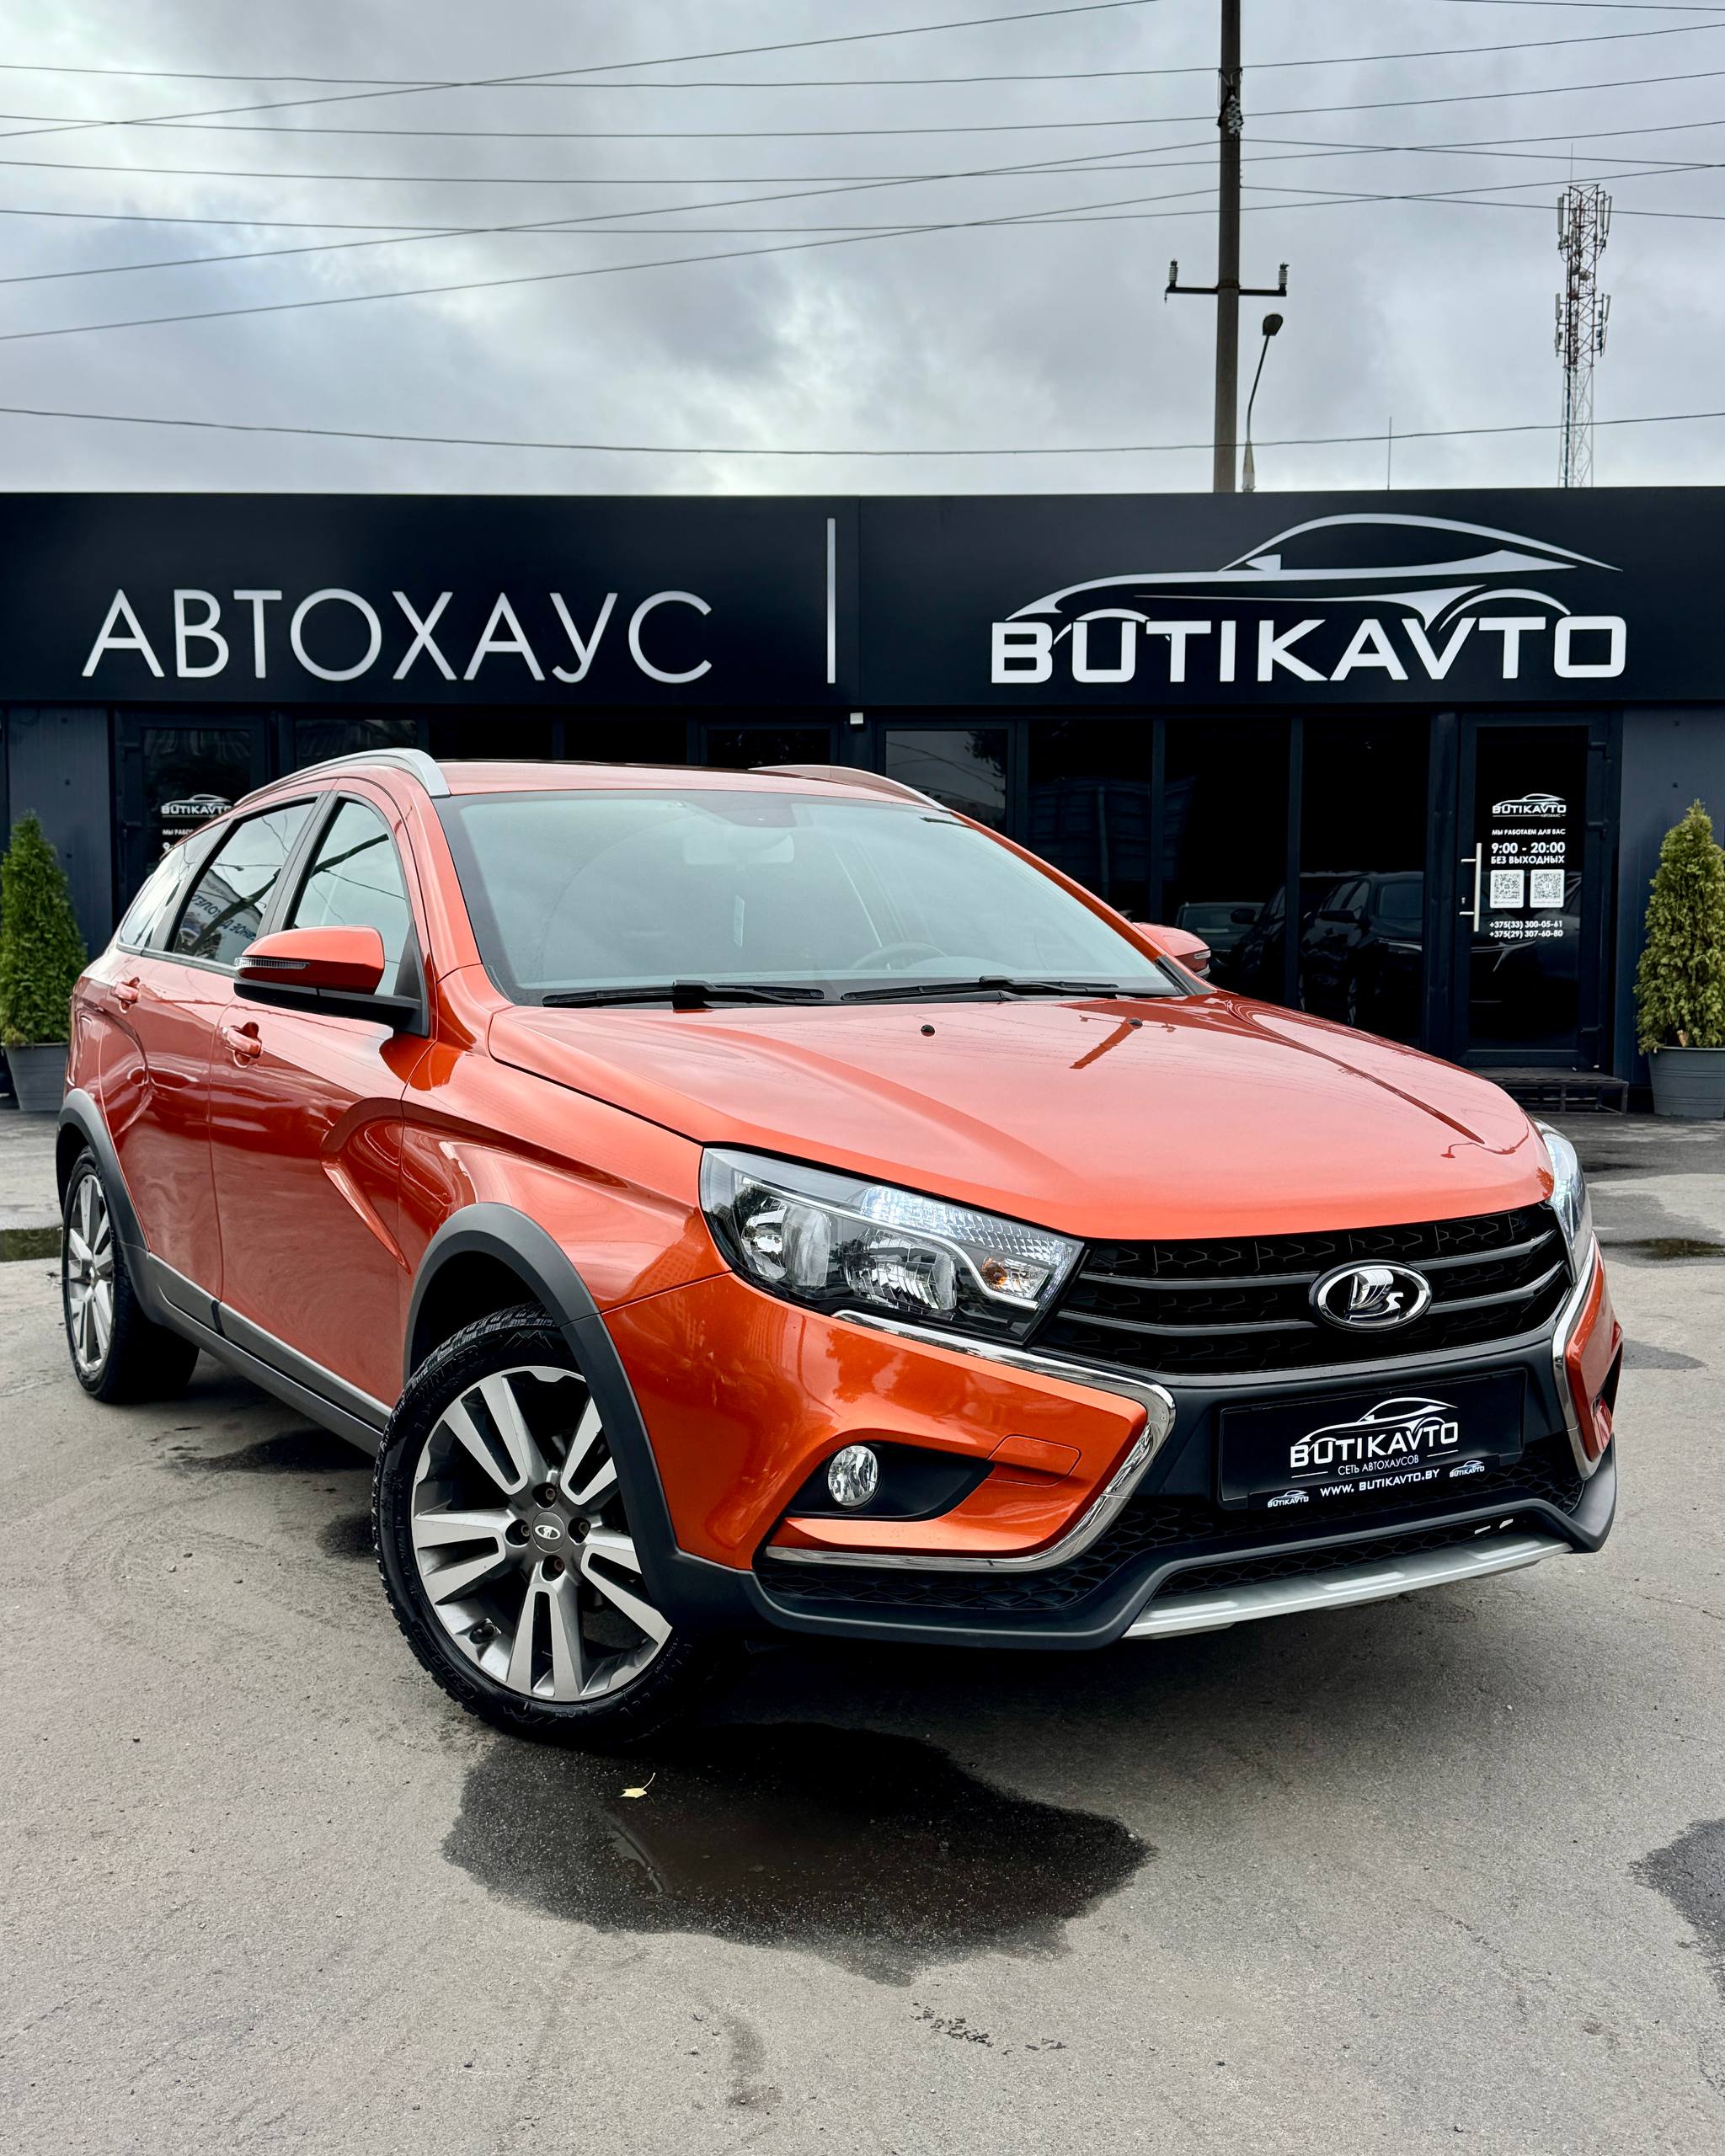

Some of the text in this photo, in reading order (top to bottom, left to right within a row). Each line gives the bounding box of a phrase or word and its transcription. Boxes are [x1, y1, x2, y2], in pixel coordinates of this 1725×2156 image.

[82, 588, 713, 684] АВТОХАУС
[991, 614, 1627, 684] BUTIKAVTO
[1492, 804, 1567, 814] BUTIKAVTO
[1492, 842, 1518, 854] 9:00
[1530, 842, 1565, 854] 20:00
[1491, 855, 1565, 865] БЕЗ ВЫХОДНЫХ
[1489, 921, 1562, 930] +375(33) 300-05-61
[1489, 930, 1523, 939] +375(29)
[1290, 1422, 1459, 1468] BUTIKAVTO
[1338, 1454, 1419, 1476] СЕТЬ АВТОХАУСОВ
[1450, 1465, 1485, 1478] BUTIKAVTO
[1320, 1469, 1440, 1497] WWW. BUTIKAVTO.BY
[1267, 1496, 1309, 1508] BUTIKAVTO
